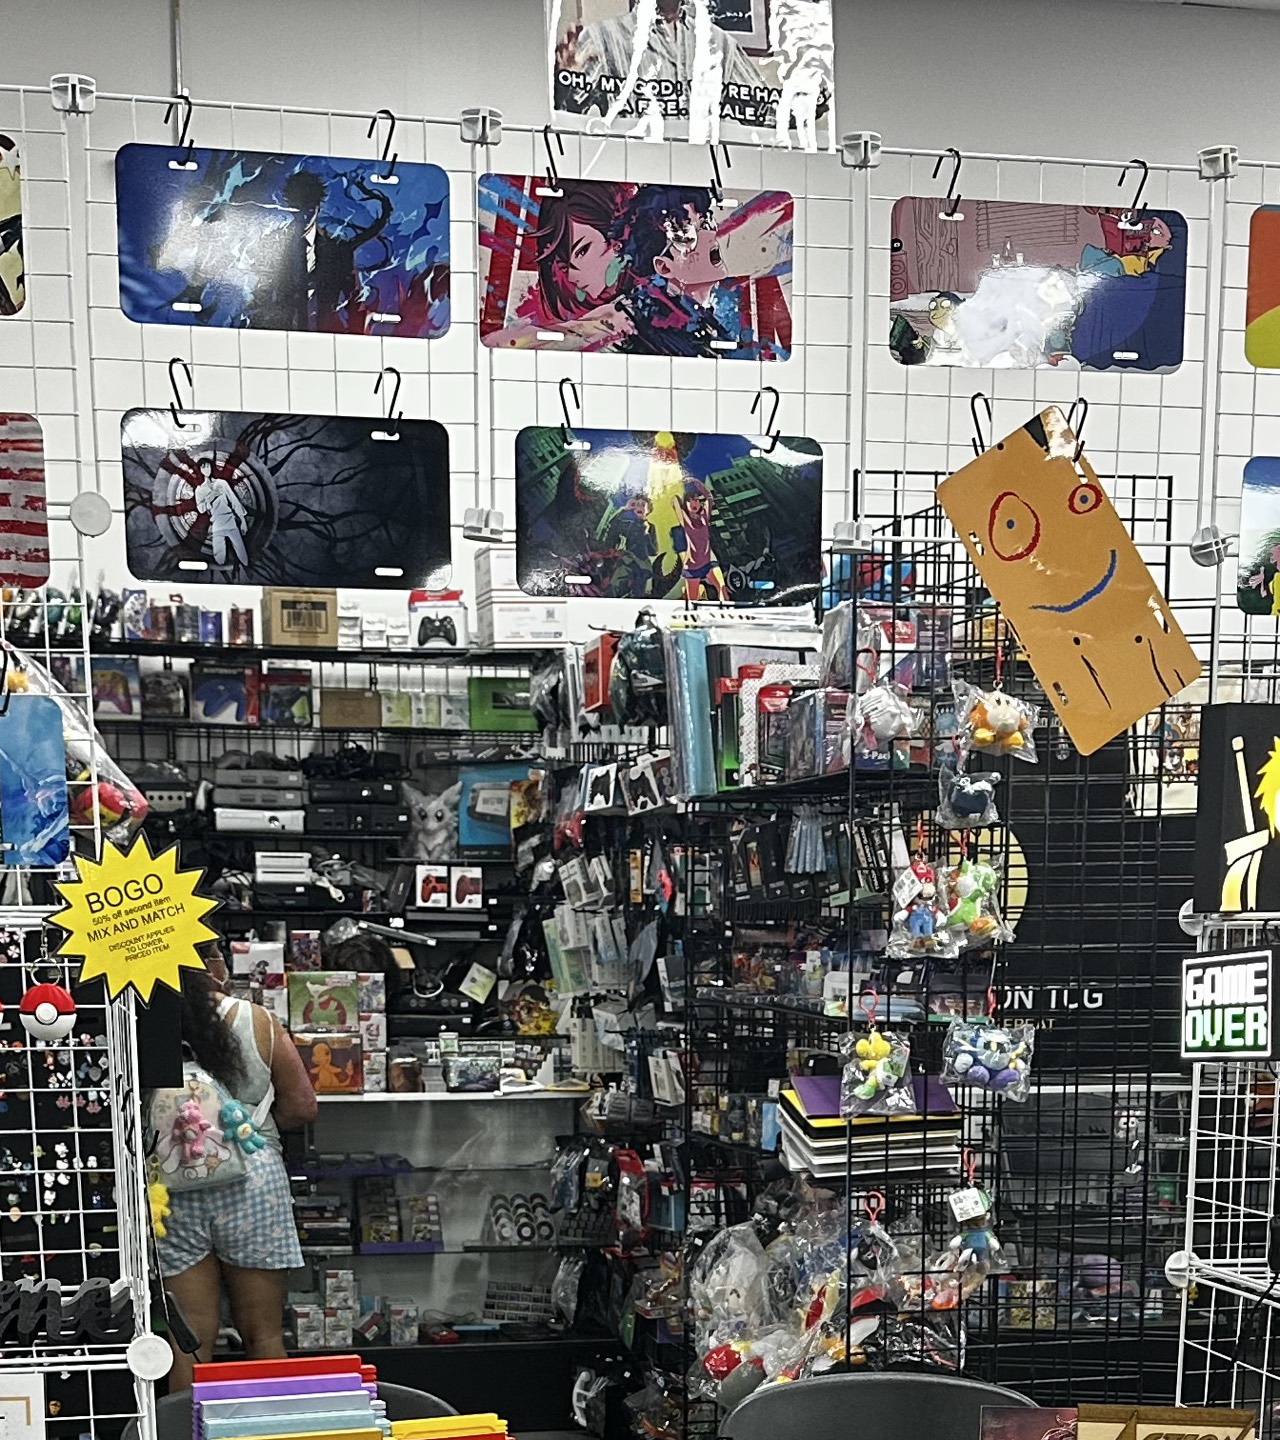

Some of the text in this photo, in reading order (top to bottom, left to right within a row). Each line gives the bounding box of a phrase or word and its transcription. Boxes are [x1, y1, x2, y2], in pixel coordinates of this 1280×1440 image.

[559, 73, 592, 90] OH,
[85, 873, 163, 914] BOGO
[87, 903, 186, 943] MIX AND MATCH
[1186, 962, 1268, 1007] GAME
[1185, 1005, 1268, 1047] OVER
